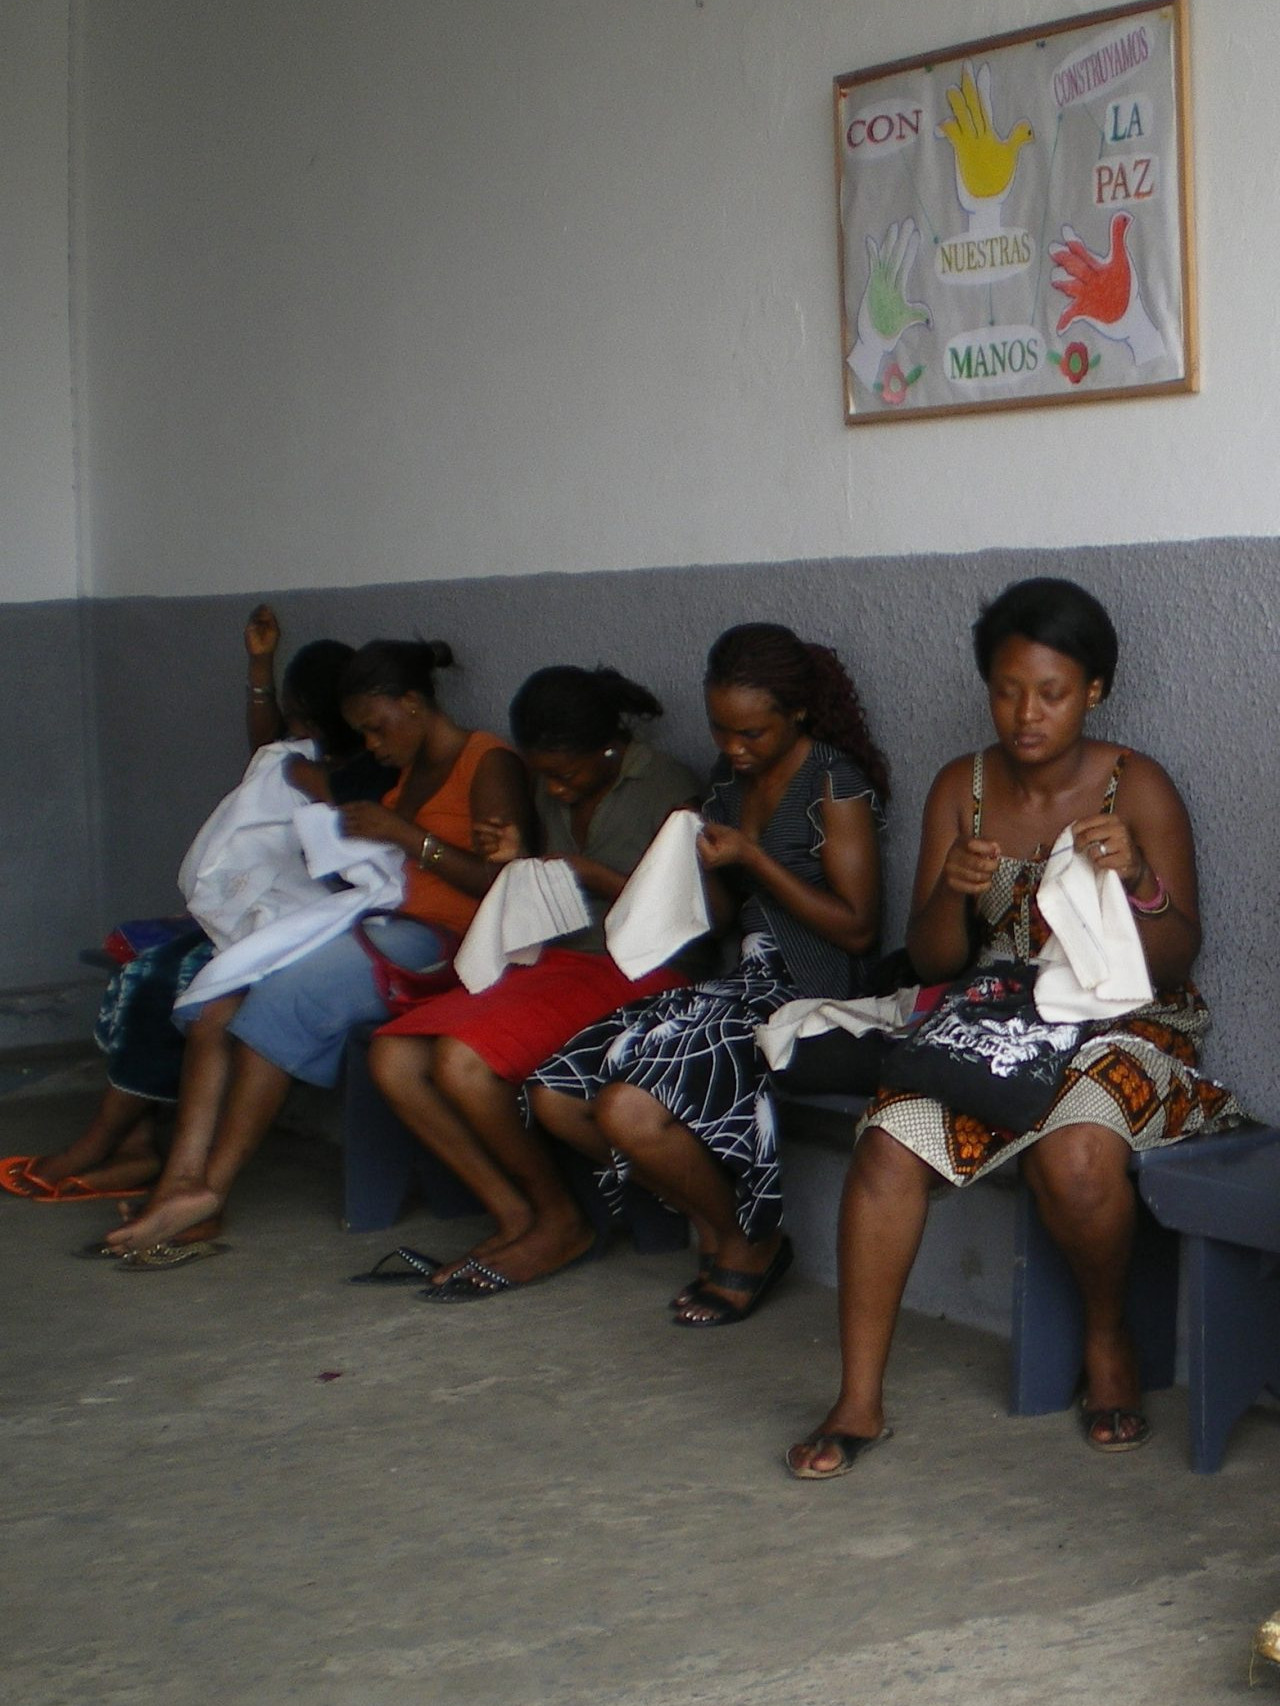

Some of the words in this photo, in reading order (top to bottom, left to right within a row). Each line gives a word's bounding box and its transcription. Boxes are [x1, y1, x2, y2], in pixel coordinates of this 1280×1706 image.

[1053, 26, 1149, 107] CONSTRUYAMOS
[846, 109, 922, 149] CON
[1111, 102, 1145, 141] LA
[1095, 159, 1154, 204] PAZ
[940, 234, 1031, 275] NUESTRAS
[949, 339, 1039, 380] MANOS
